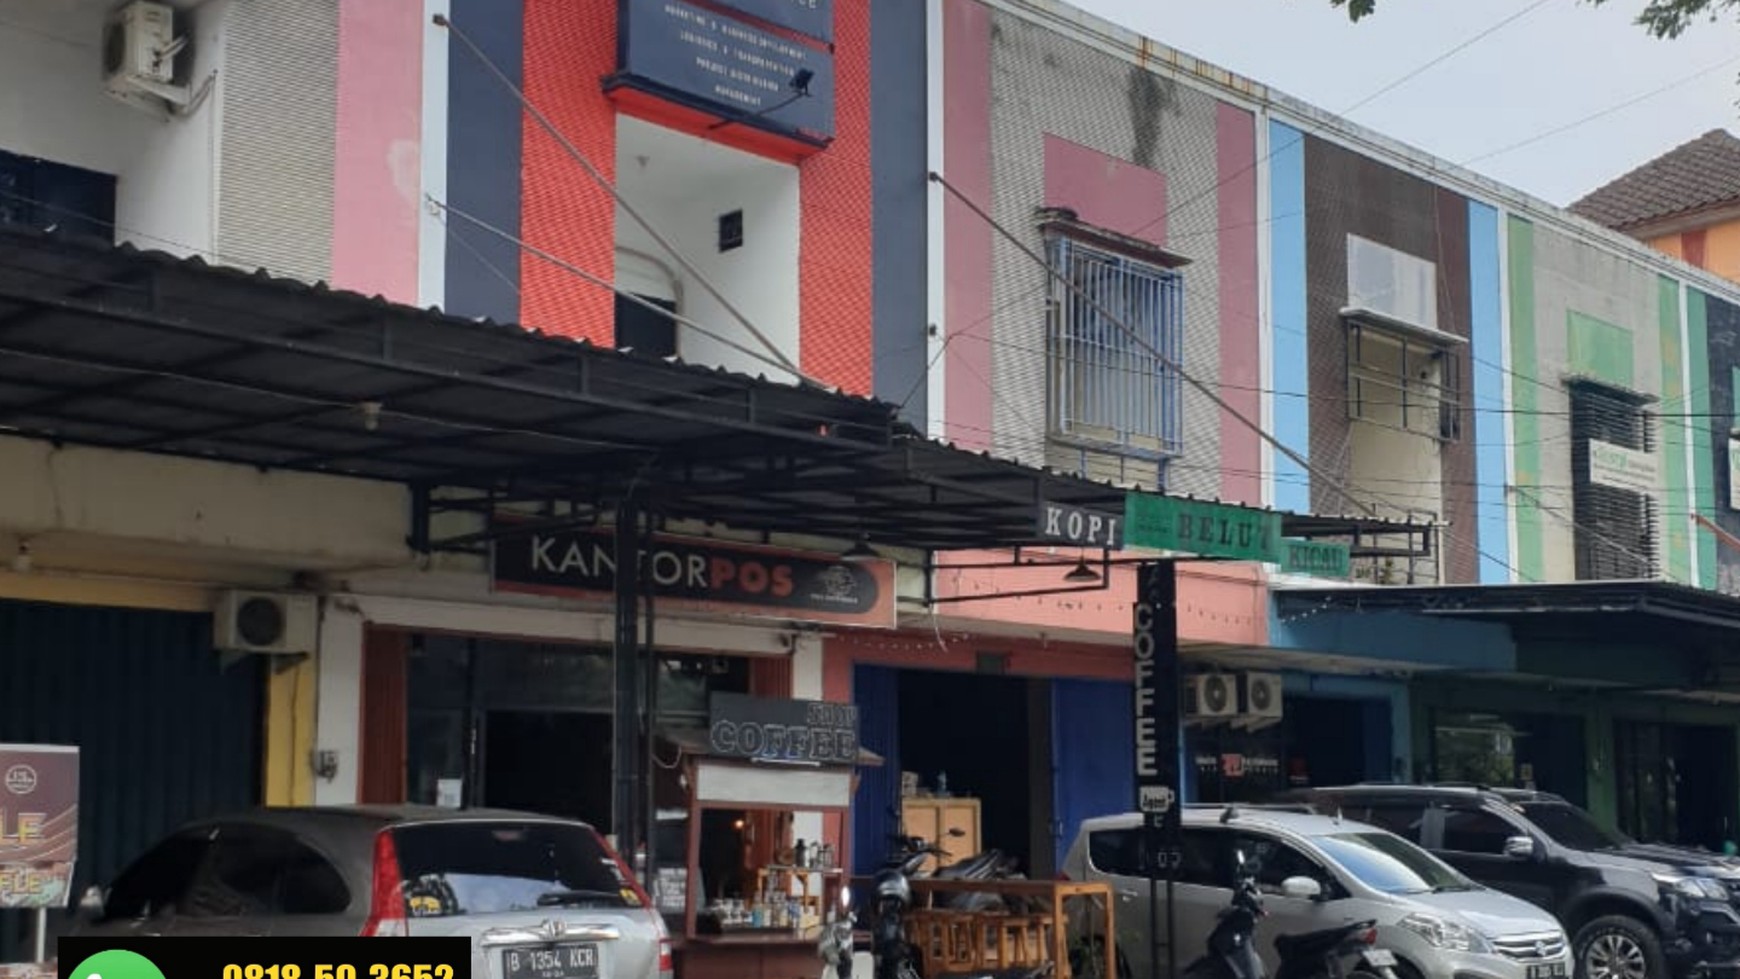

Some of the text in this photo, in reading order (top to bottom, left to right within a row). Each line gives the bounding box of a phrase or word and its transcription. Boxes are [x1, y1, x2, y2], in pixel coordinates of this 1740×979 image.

[1045, 507, 1118, 546] KOPI
[1135, 603, 1157, 776] COFFEE
[711, 719, 857, 761] COFFEE
[511, 952, 520, 972] B
[530, 949, 562, 972] 1354
